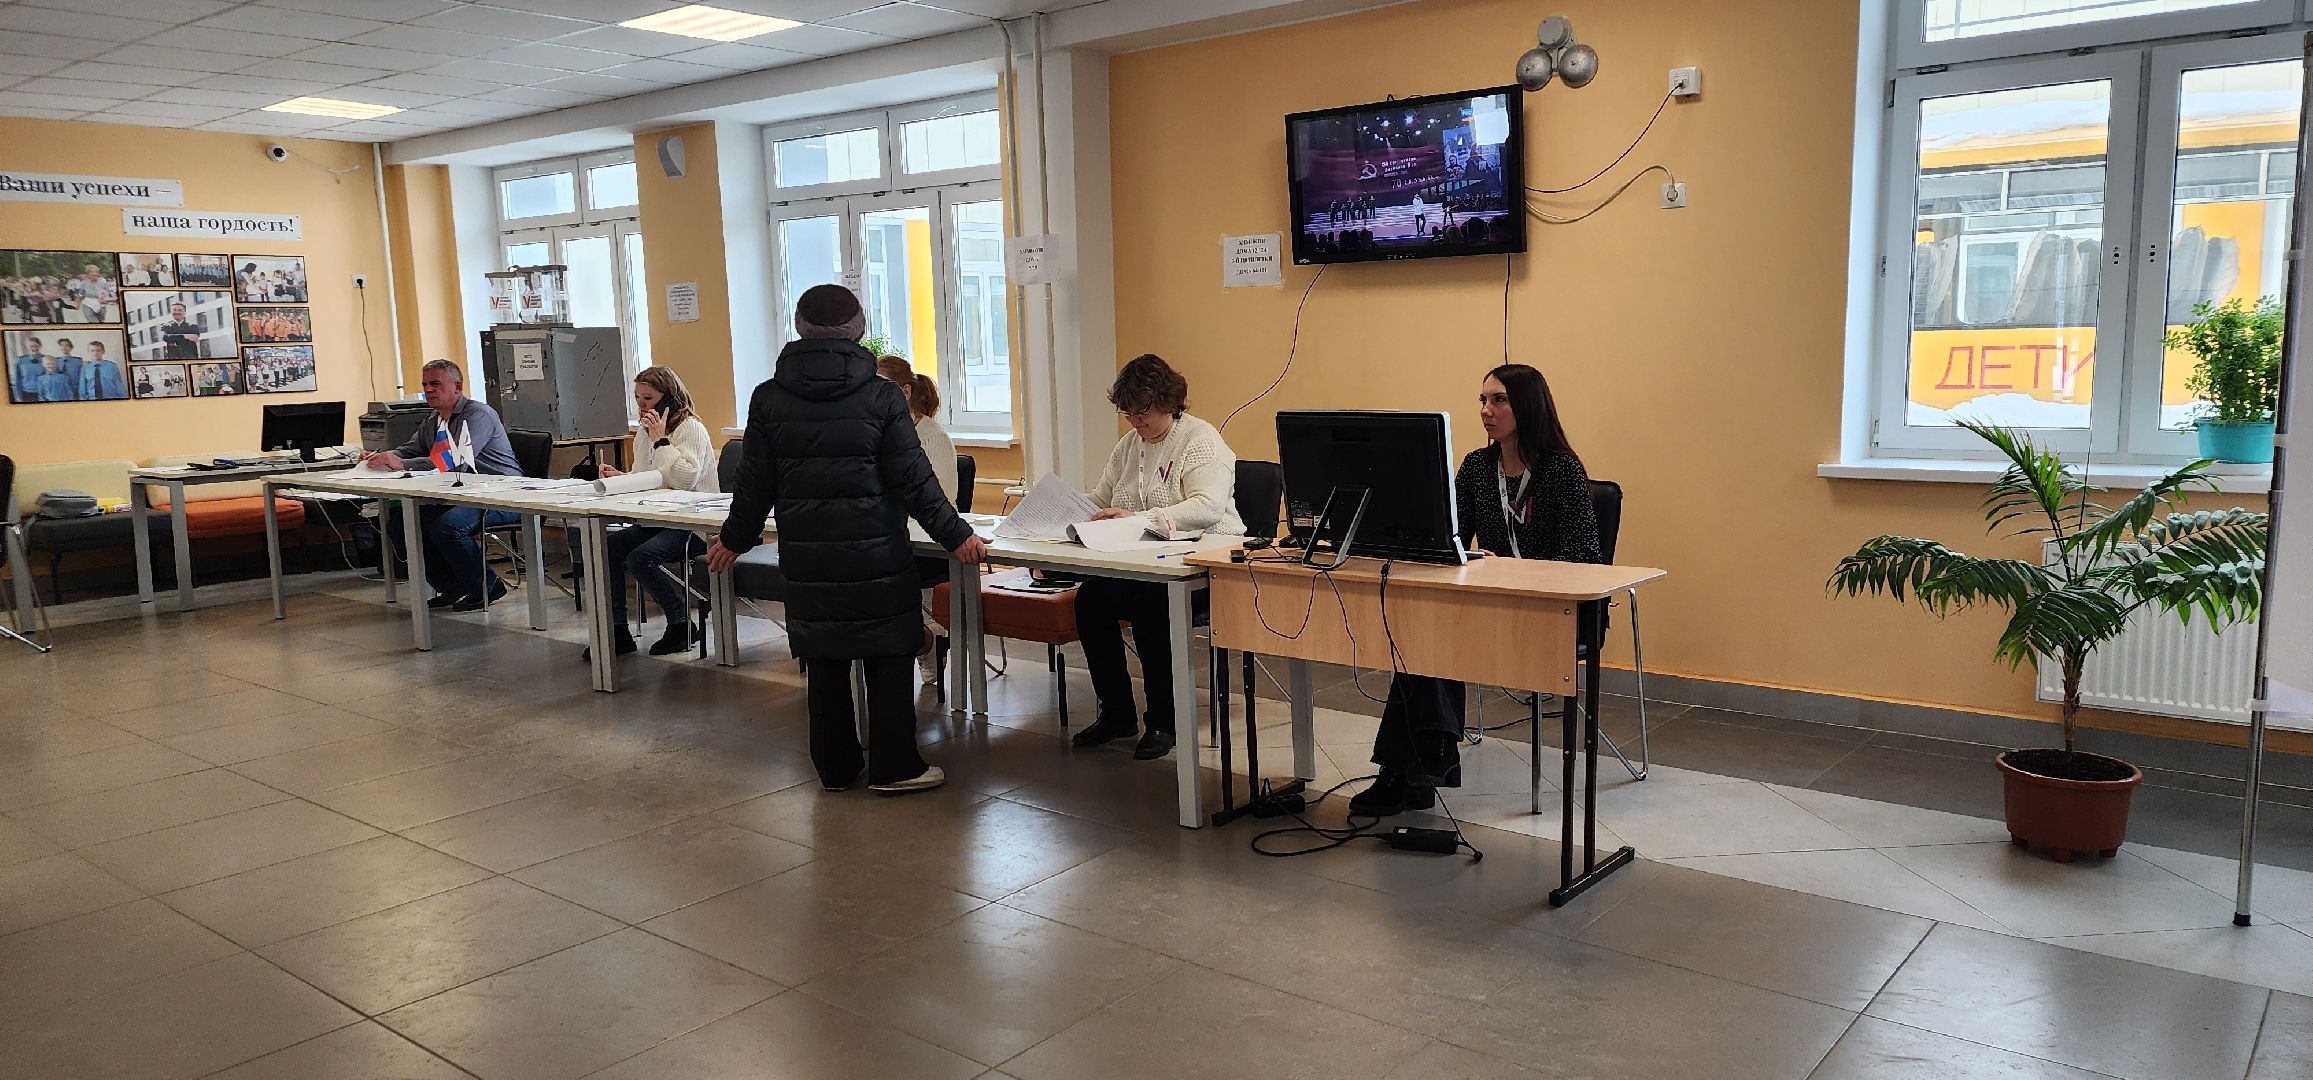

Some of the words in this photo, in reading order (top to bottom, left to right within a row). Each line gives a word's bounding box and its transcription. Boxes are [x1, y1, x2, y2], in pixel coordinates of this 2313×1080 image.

[0, 175, 65, 194] Ваши
[70, 181, 150, 199] успехи
[132, 215, 192, 229] наша
[199, 218, 294, 234] гордость!
